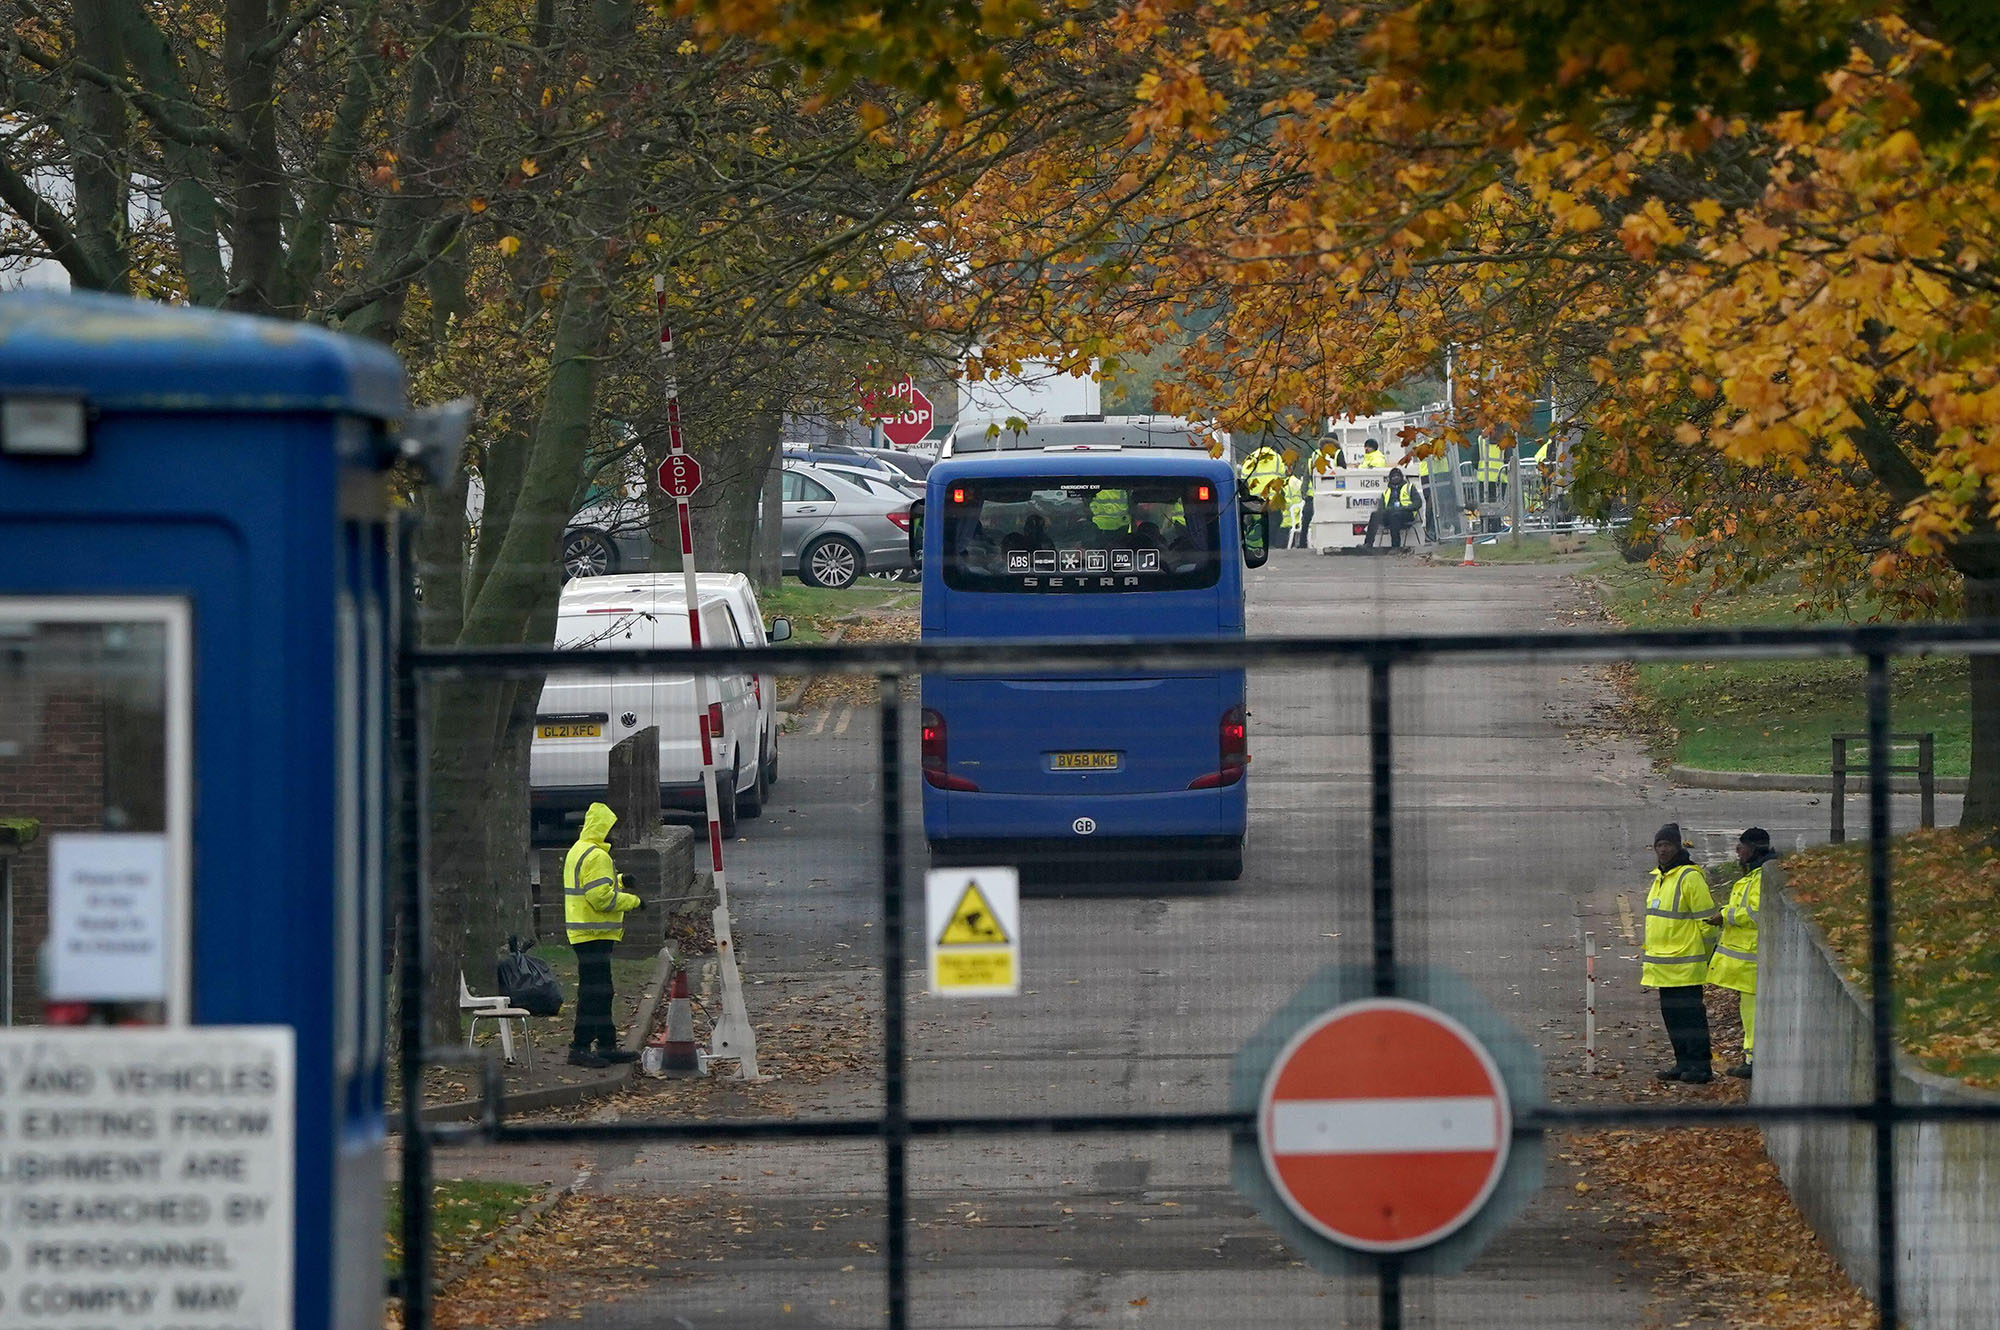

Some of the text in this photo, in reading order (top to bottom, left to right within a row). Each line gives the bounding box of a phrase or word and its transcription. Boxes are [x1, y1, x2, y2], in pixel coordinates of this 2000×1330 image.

[673, 457, 687, 494] STOP
[1010, 556, 1028, 567] ABS
[1092, 558, 1100, 566] TV
[1116, 554, 1128, 562] DVD
[1024, 576, 1139, 587] SETRA
[544, 725, 595, 737] GL21 XFC
[1058, 754, 1116, 767] BV58 MKE
[1074, 820, 1093, 832] GB
[20, 1065, 95, 1096] AND
[107, 1064, 278, 1097] VEHICLES
[20, 1107, 156, 1140] EXITING
[170, 1107, 273, 1140] FROM
[181, 1152, 249, 1184] ARE
[20, 1194, 270, 1228] SEARCHED BY
[25, 1239, 233, 1272] PERSONNEL
[19, 1282, 156, 1316] COMPLY
[172, 1282, 244, 1313] MAY
